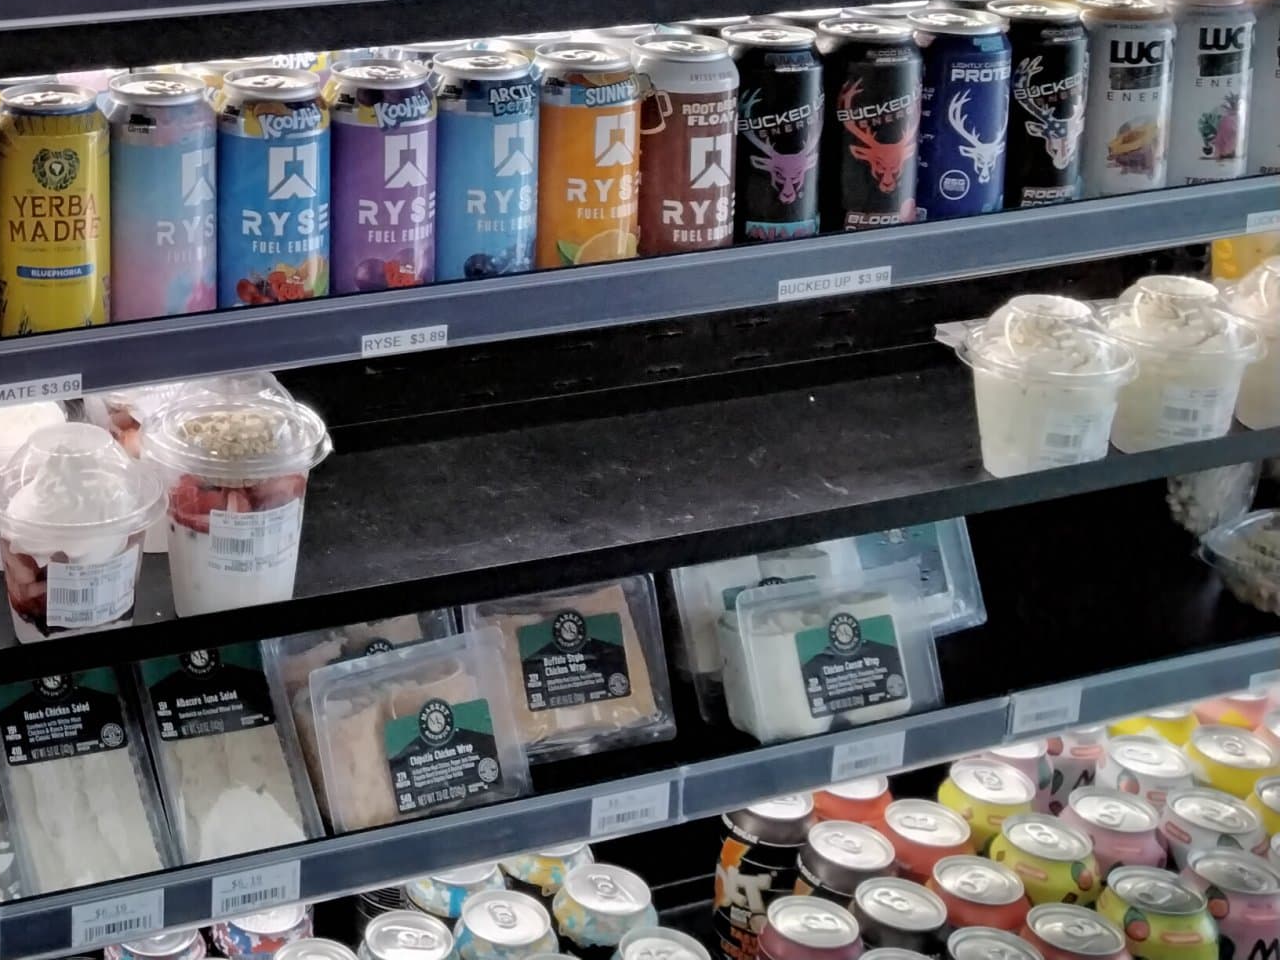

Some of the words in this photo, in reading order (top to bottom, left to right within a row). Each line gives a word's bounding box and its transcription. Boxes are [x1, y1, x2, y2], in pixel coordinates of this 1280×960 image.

[374, 90, 430, 129] Kool-Aid
[682, 103, 714, 116] ROOT
[738, 105, 810, 131] BUCKED
[837, 97, 914, 122] BUCKED
[259, 103, 321, 140] Kool-Aid
[688, 112, 735, 127] FLOAT
[13, 193, 97, 218] YERBA
[577, 207, 605, 220] FUEL
[242, 203, 329, 236] RYSE
[477, 218, 505, 232] FUEL
[848, 213, 899, 225] BLOOD
[7, 216, 101, 243] MADRE
[368, 229, 396, 243] FUEL
[673, 228, 702, 242] FUEL
[252, 240, 280, 254] FUEL
[779, 278, 831, 298] BUCKED
[833, 275, 852, 290] UP
[364, 336, 402, 352] RYSE
[41, 378, 81, 397] $3.69
[545, 665, 569, 677] Chicken
[569, 663, 587, 673] Wrap
[823, 664, 845, 676] Chicken
[863, 656, 880, 667] Wrap
[176, 696, 202, 708] Albacore
[203, 693, 218, 704] Tuna
[219, 689, 238, 701] Salad
[24, 709, 44, 721] Ranch
[45, 705, 71, 718] Chicken
[71, 700, 91, 714] Salad
[410, 753, 434, 766] Chipotle
[434, 748, 456, 760] Chicken
[457, 743, 474, 755] Wrap
